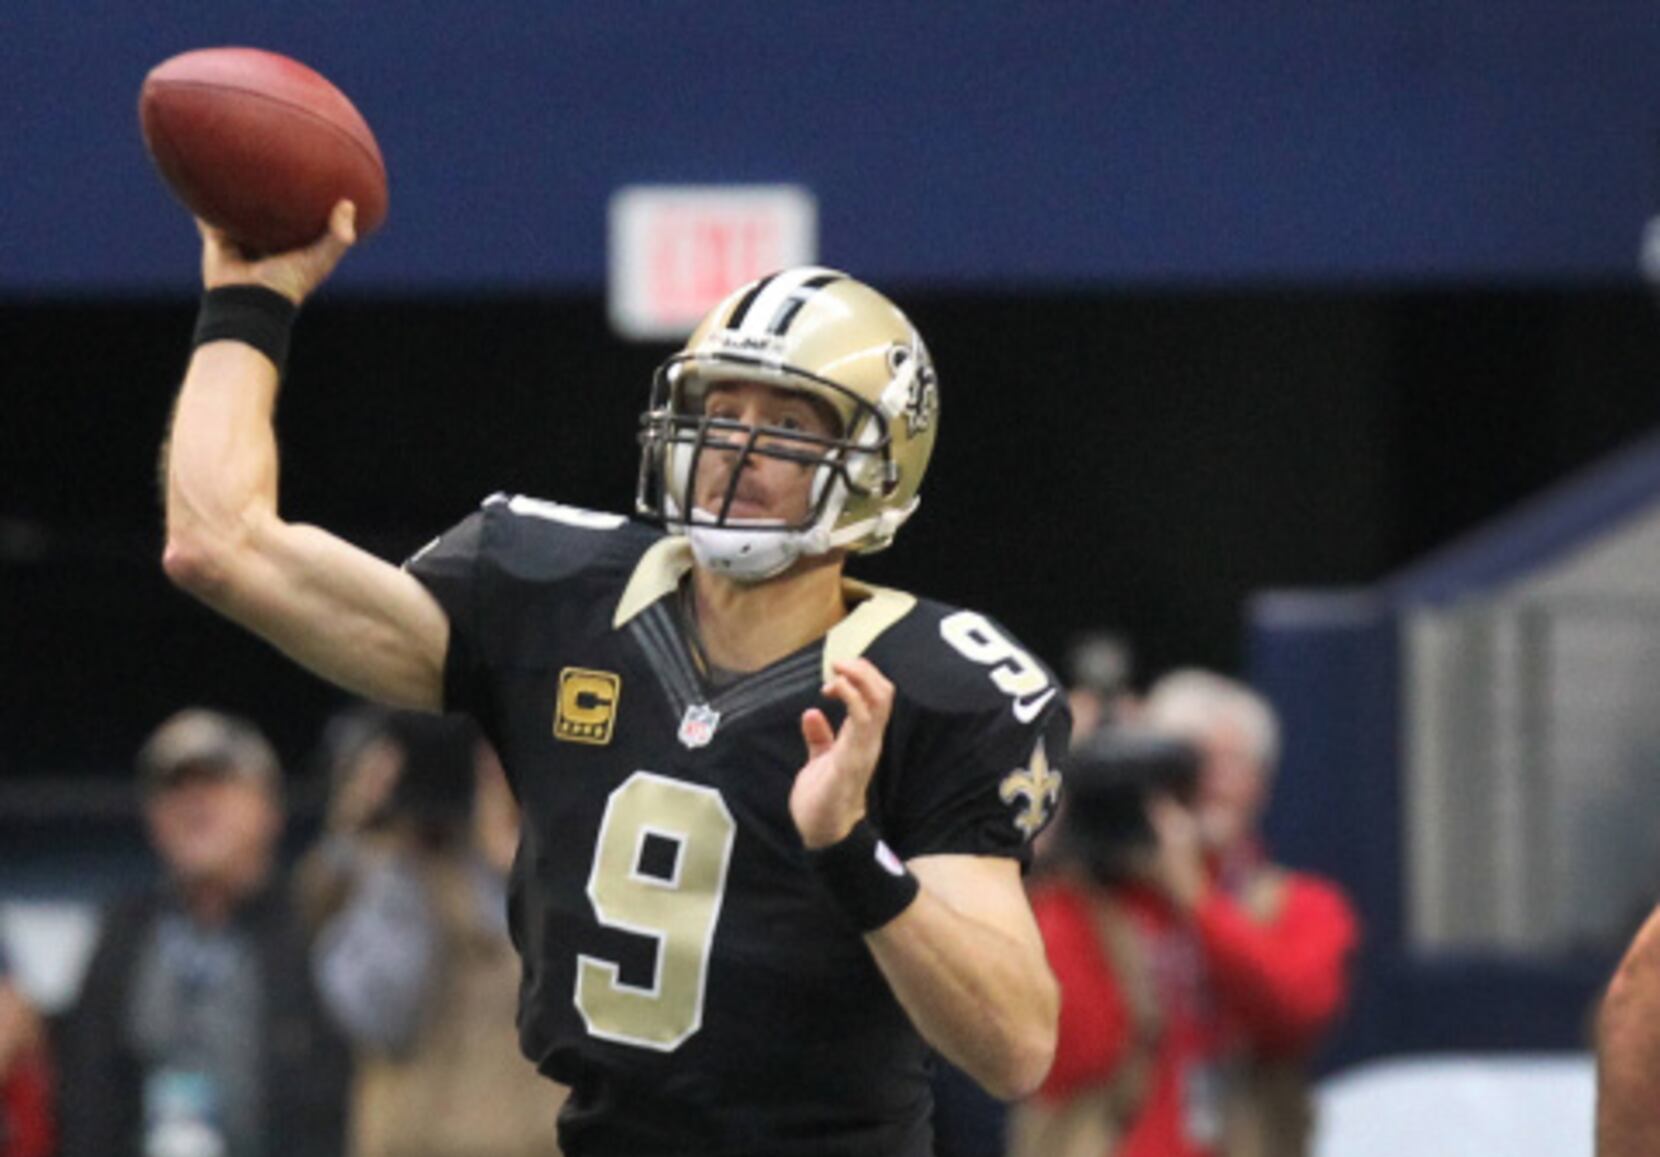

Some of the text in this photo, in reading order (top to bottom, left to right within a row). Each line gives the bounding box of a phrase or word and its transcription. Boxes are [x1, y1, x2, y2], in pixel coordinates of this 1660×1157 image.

[939, 608, 1050, 698] 9
[561, 674, 616, 725] C
[572, 769, 738, 1053] 9
